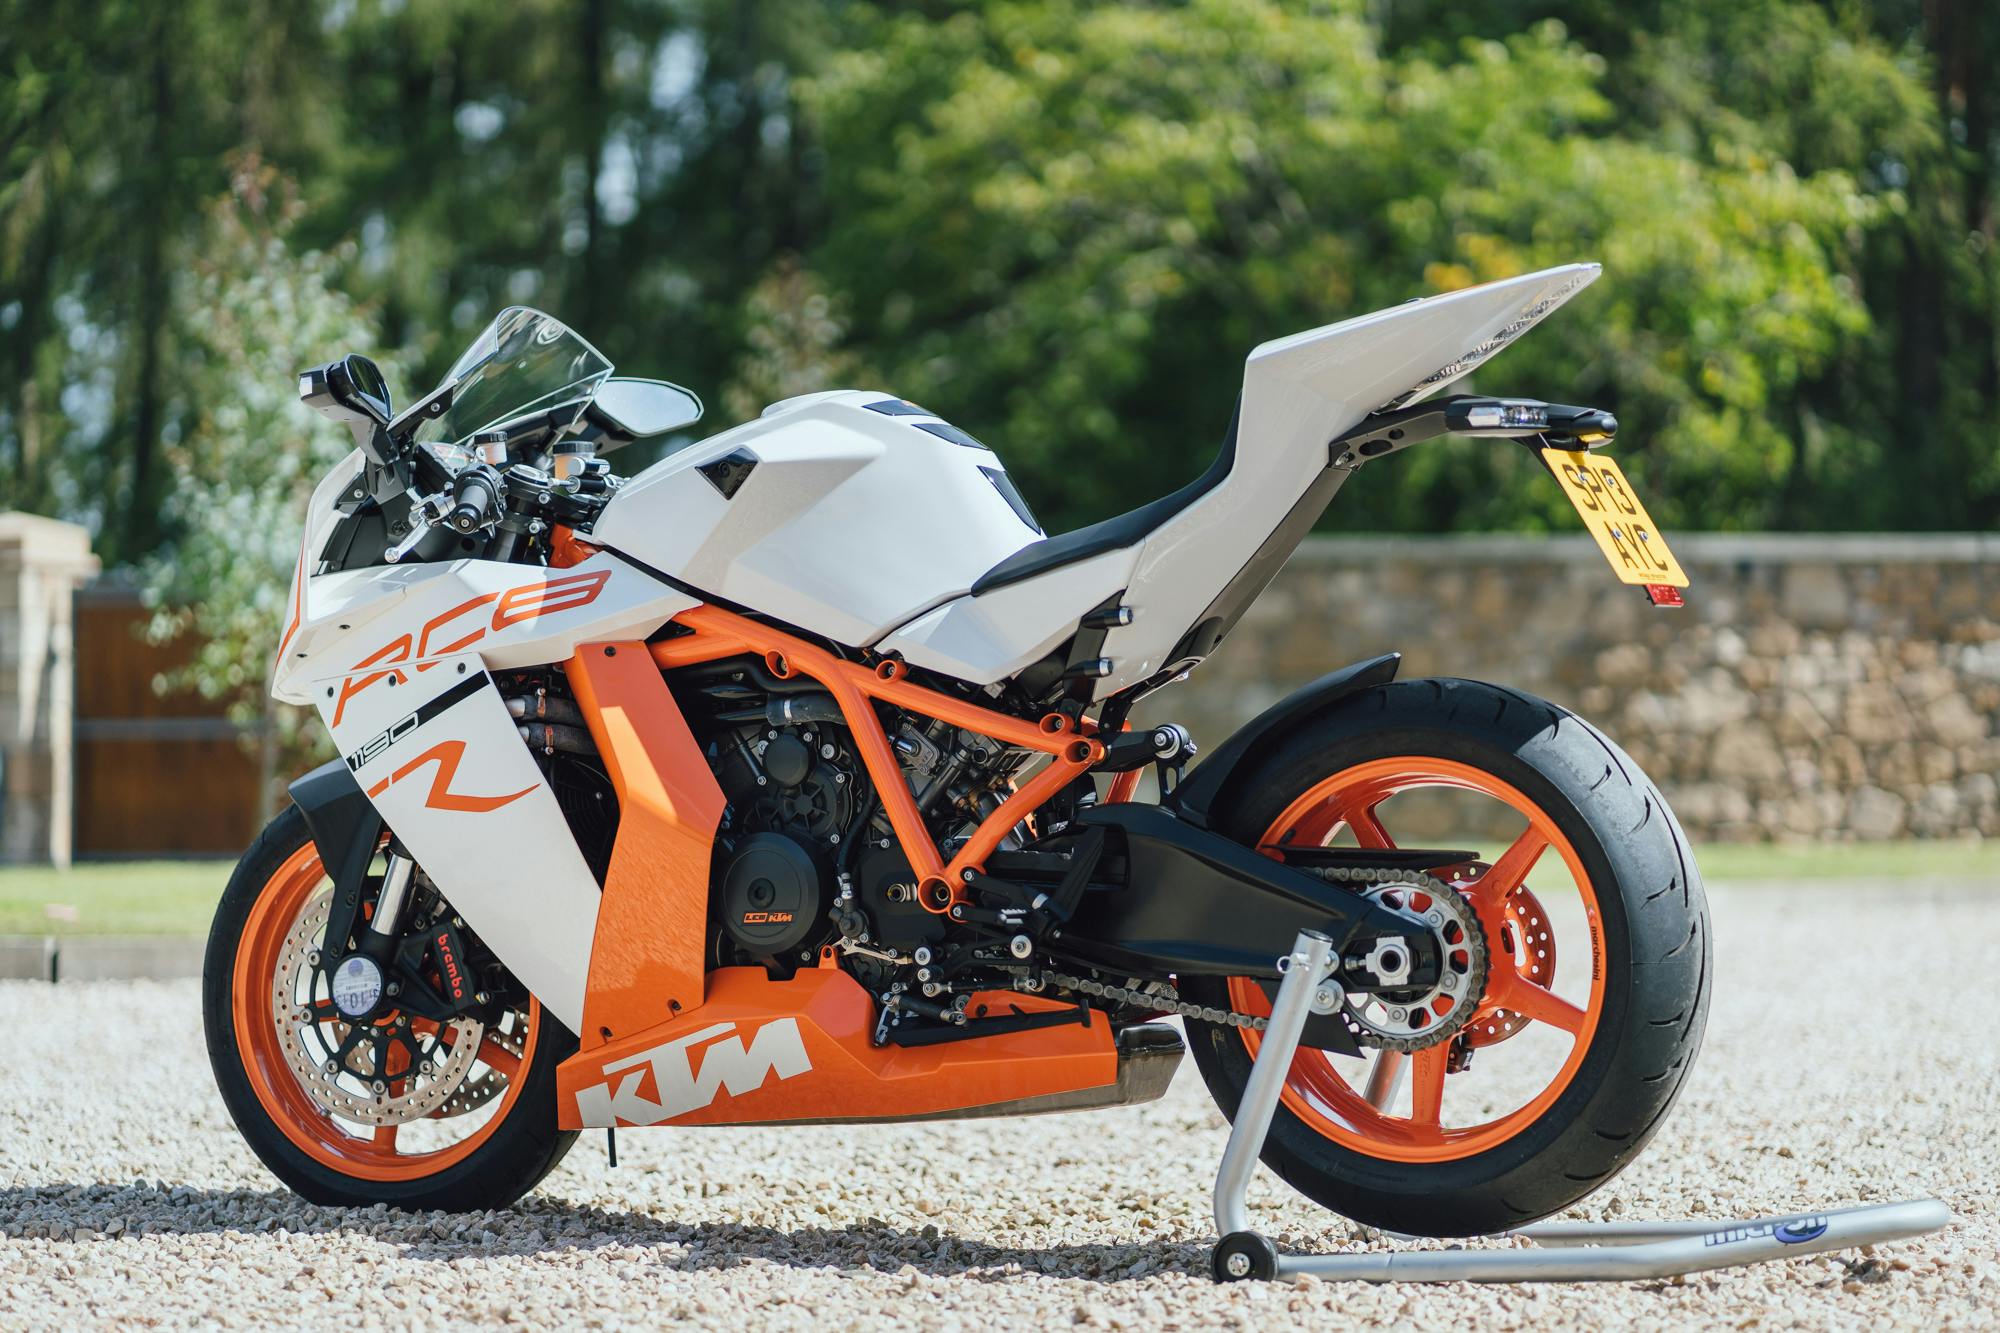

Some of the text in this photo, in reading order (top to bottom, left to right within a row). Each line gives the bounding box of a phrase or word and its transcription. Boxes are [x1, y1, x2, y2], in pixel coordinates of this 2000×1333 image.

[1562, 463, 1637, 516] SP13
[1603, 521, 1669, 571] AYC
[347, 711, 420, 772] 1190
[768, 912, 793, 922] KTM
[438, 932, 463, 999] brembo
[1590, 926, 1601, 980] marchesini
[575, 1017, 813, 1128] KTM
